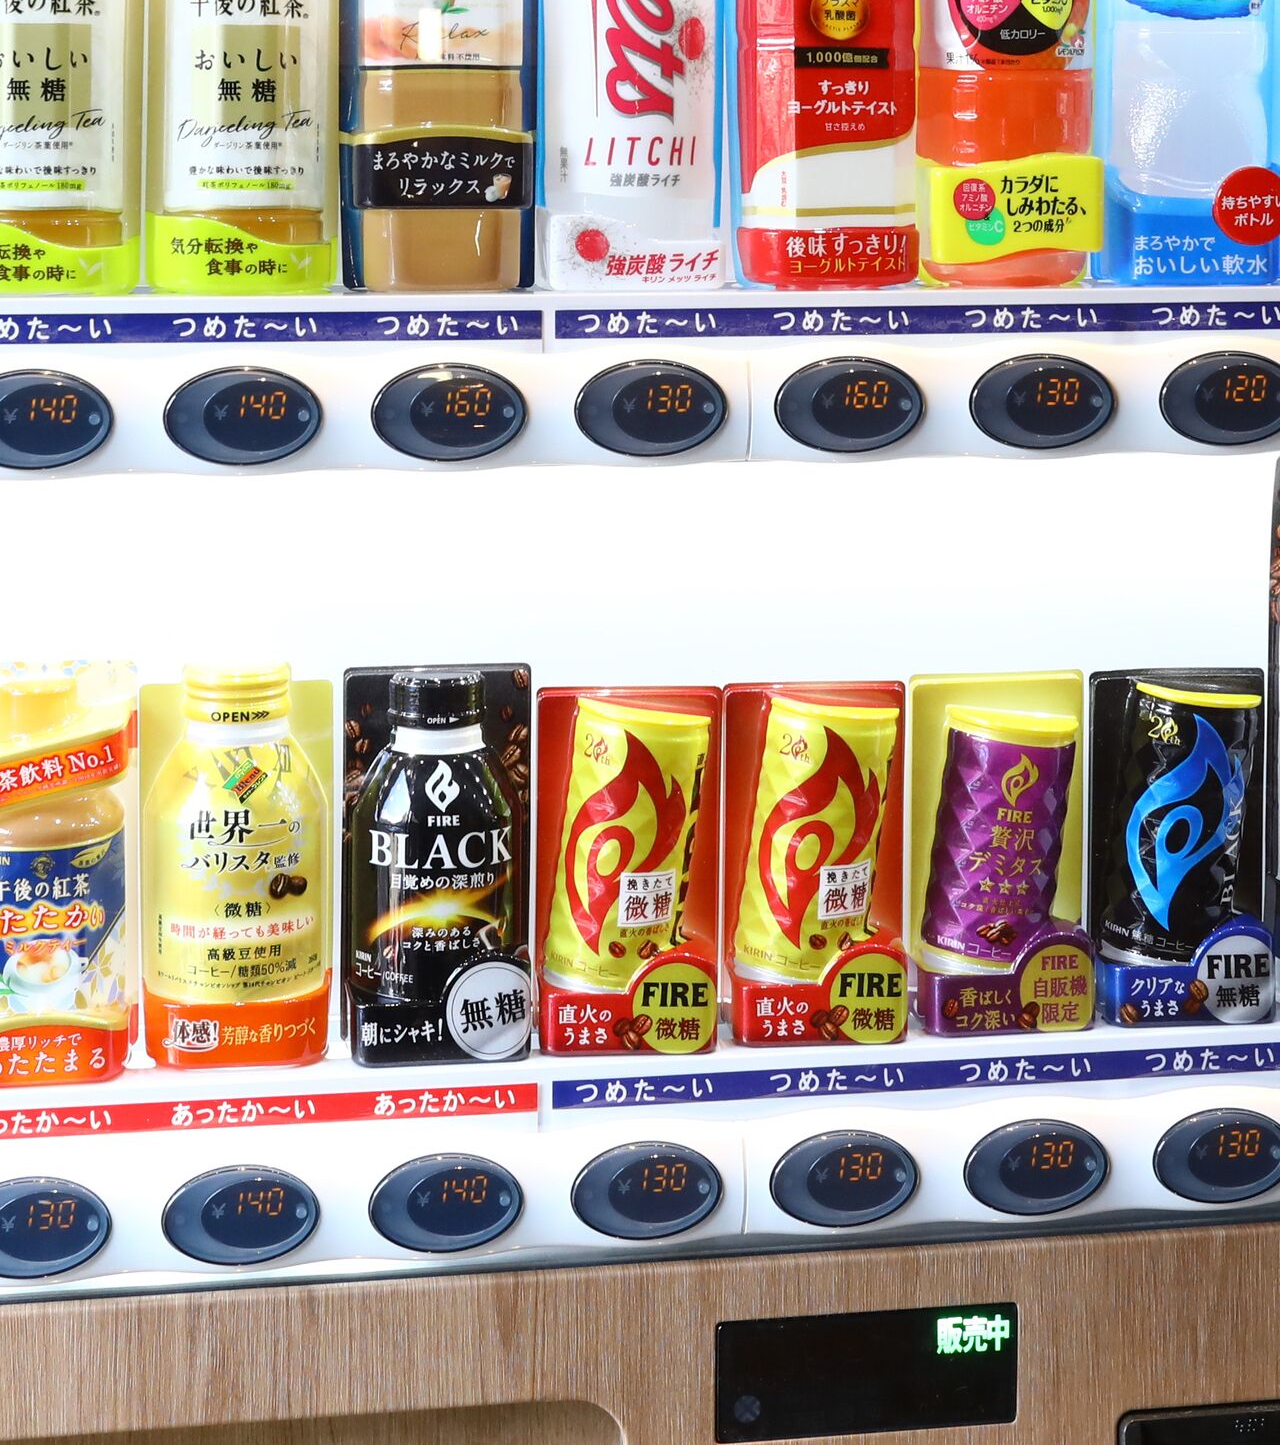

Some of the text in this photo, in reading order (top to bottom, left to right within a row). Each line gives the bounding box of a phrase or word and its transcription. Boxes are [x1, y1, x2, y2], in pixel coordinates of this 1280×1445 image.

[1000, 28, 1047, 40] 低カロリー
[6, 78, 67, 101] 無糖
[818, 80, 870, 95] すっきり
[787, 100, 898, 118] ヨーグルトテイスト
[70, 114, 105, 130] Tea
[372, 151, 515, 172] まろやかなミルクで
[583, 135, 696, 167] LITCHI
[398, 176, 480, 197] リラックス
[1000, 176, 1059, 196] カラダに
[1134, 235, 1215, 252] まろやかで
[606, 250, 719, 276] 強炭酸ライチ
[1134, 254, 1268, 276] おいしい軟水
[445, 389, 491, 416] 160
[211, 711, 249, 722] OPEN
[427, 716, 446, 725] OPEN
[70, 745, 115, 773] No.1
[427, 814, 460, 826] FIRE
[997, 809, 1033, 823] FIRE
[369, 826, 512, 869] BLACK
[969, 852, 1042, 877] デミタス
[624, 894, 671, 921] 微糖
[207, 945, 282, 961] 高級豆使用
[1206, 954, 1269, 978] FIRE
[642, 983, 709, 1008] FIRE
[839, 972, 901, 998] FIRE
[1033, 976, 1087, 999] 自販機
[460, 988, 526, 1033] 無糖
[1041, 1001, 1080, 1022] 限定
[564, 1027, 608, 1045] うまさ
[238, 1188, 284, 1216] 140
[937, 1315, 1010, 1354] 販売中
